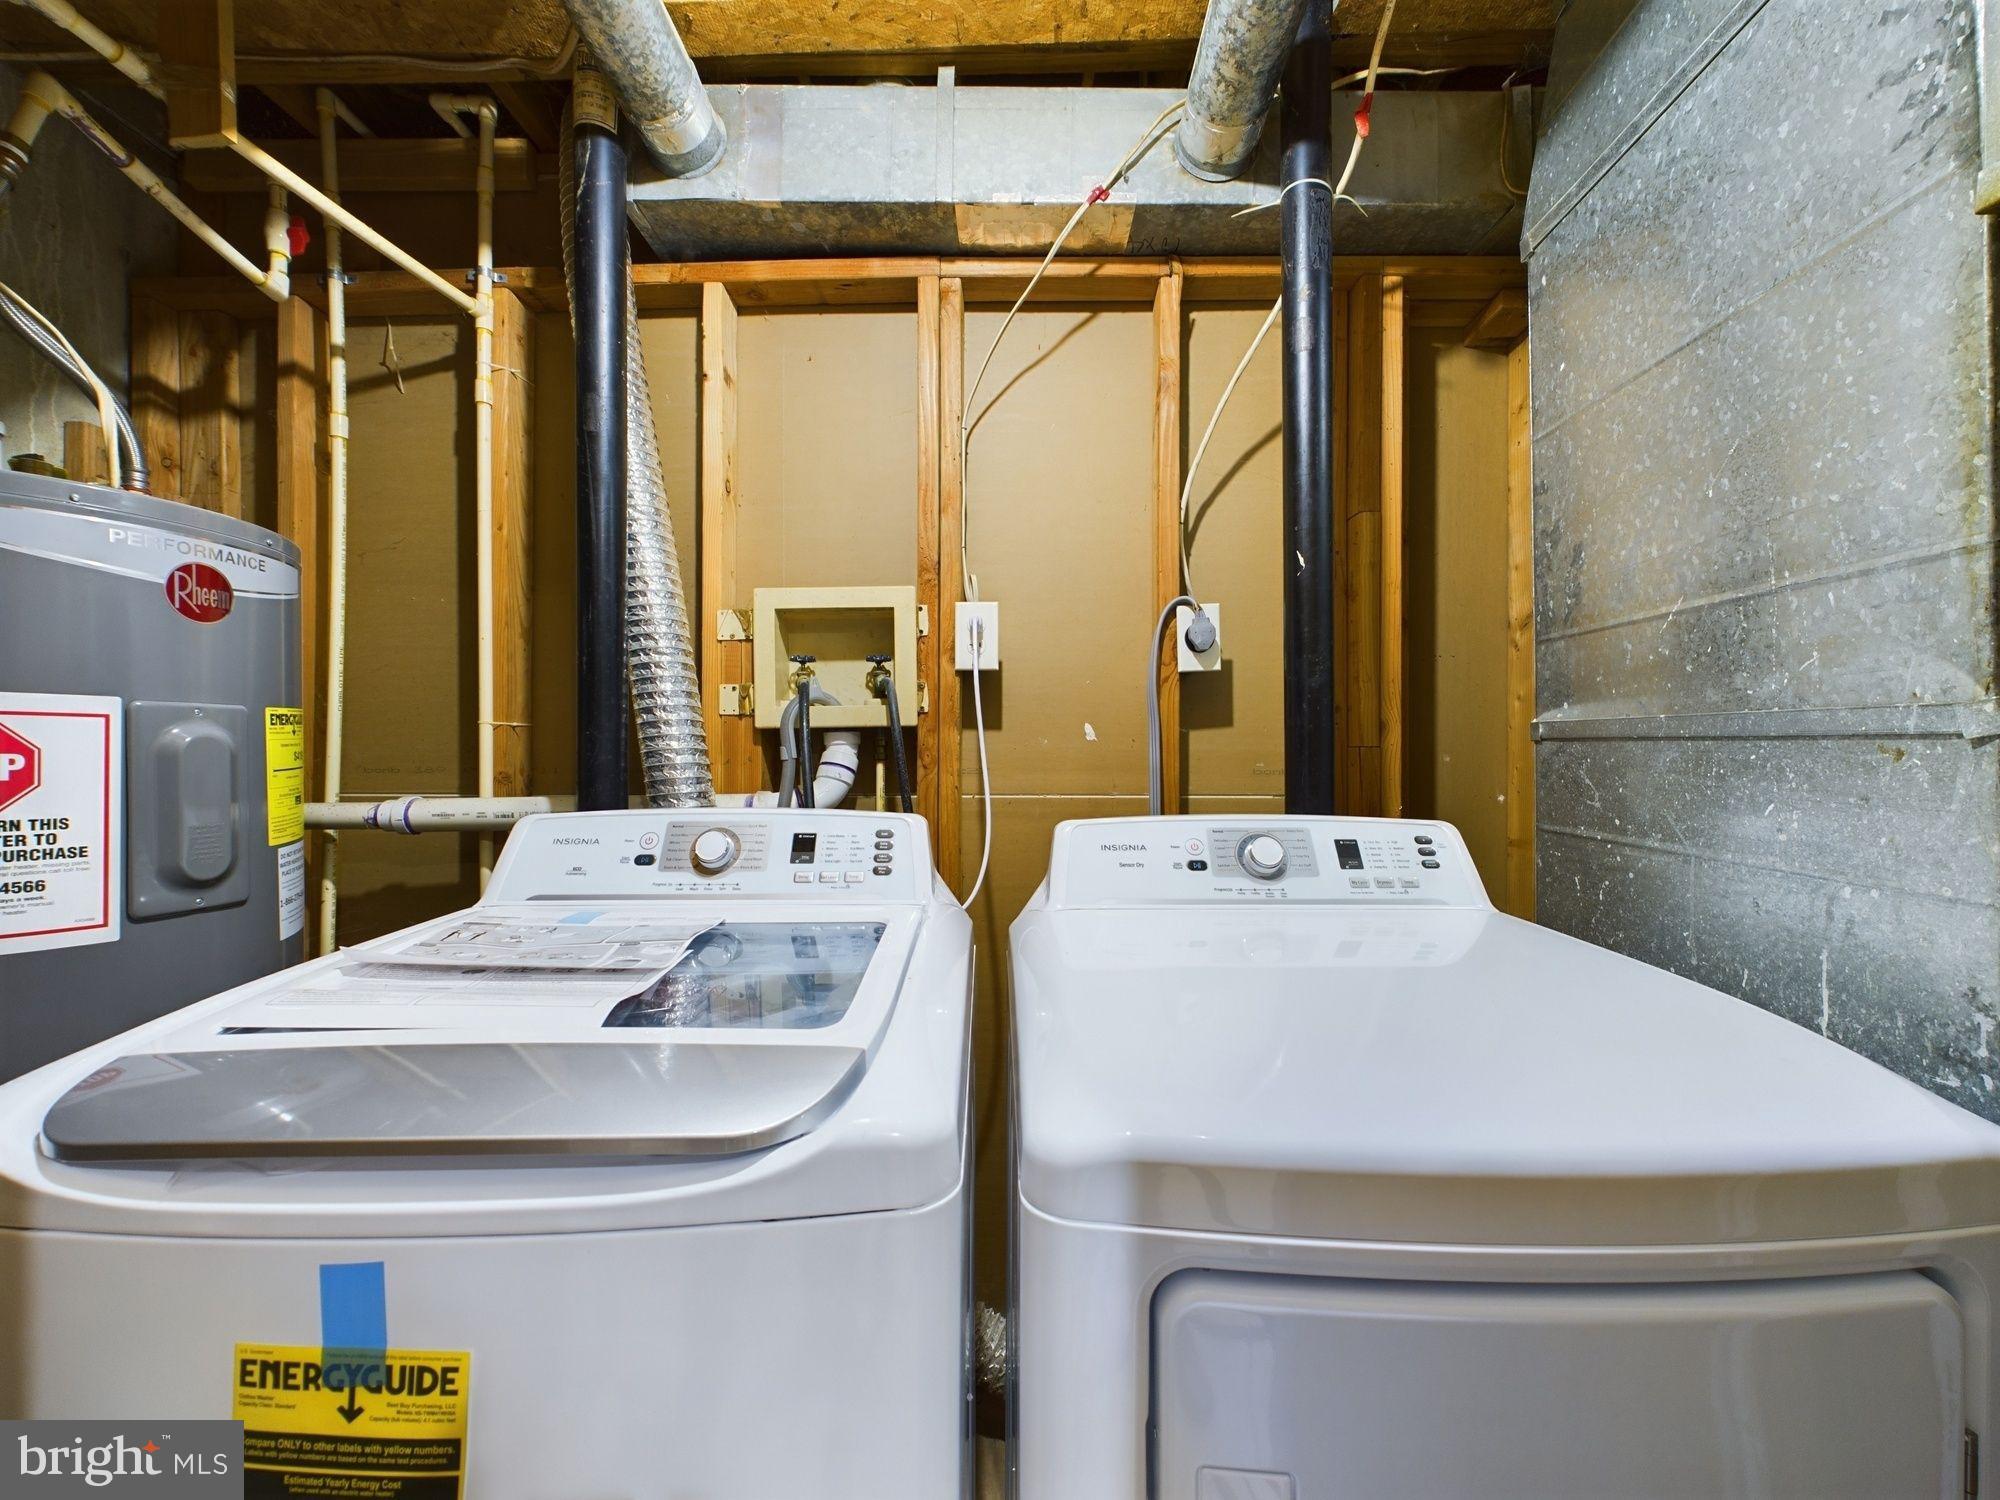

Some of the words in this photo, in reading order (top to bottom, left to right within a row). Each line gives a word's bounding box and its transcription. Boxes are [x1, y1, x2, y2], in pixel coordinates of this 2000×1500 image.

[109, 527, 267, 573] PERFORMANCE
[173, 564, 231, 613] Rheem
[27, 818, 70, 831] THIS
[33, 833, 58, 845] TO
[553, 838, 600, 846] INSIGNIA
[0, 846, 89, 862] URCHASE
[1100, 844, 1147, 852] INSIGNIA
[239, 1358, 460, 1397] ENERGYGUIDE
[244, 1438, 275, 1449] ompare
[277, 1438, 302, 1450] ONLY
[303, 1441, 312, 1450] to
[313, 1442, 336, 1451] other
[337, 1443, 362, 1453] labels
[364, 1444, 381, 1454] with
[384, 1445, 412, 1456] yellow
[413, 1445, 456, 1455] numbers.
[283, 1475, 323, 1486] Estimated
[325, 1477, 349, 1489] Yearly
[351, 1478, 380, 1490] Energy
[381, 1480, 402, 1489] Cost
